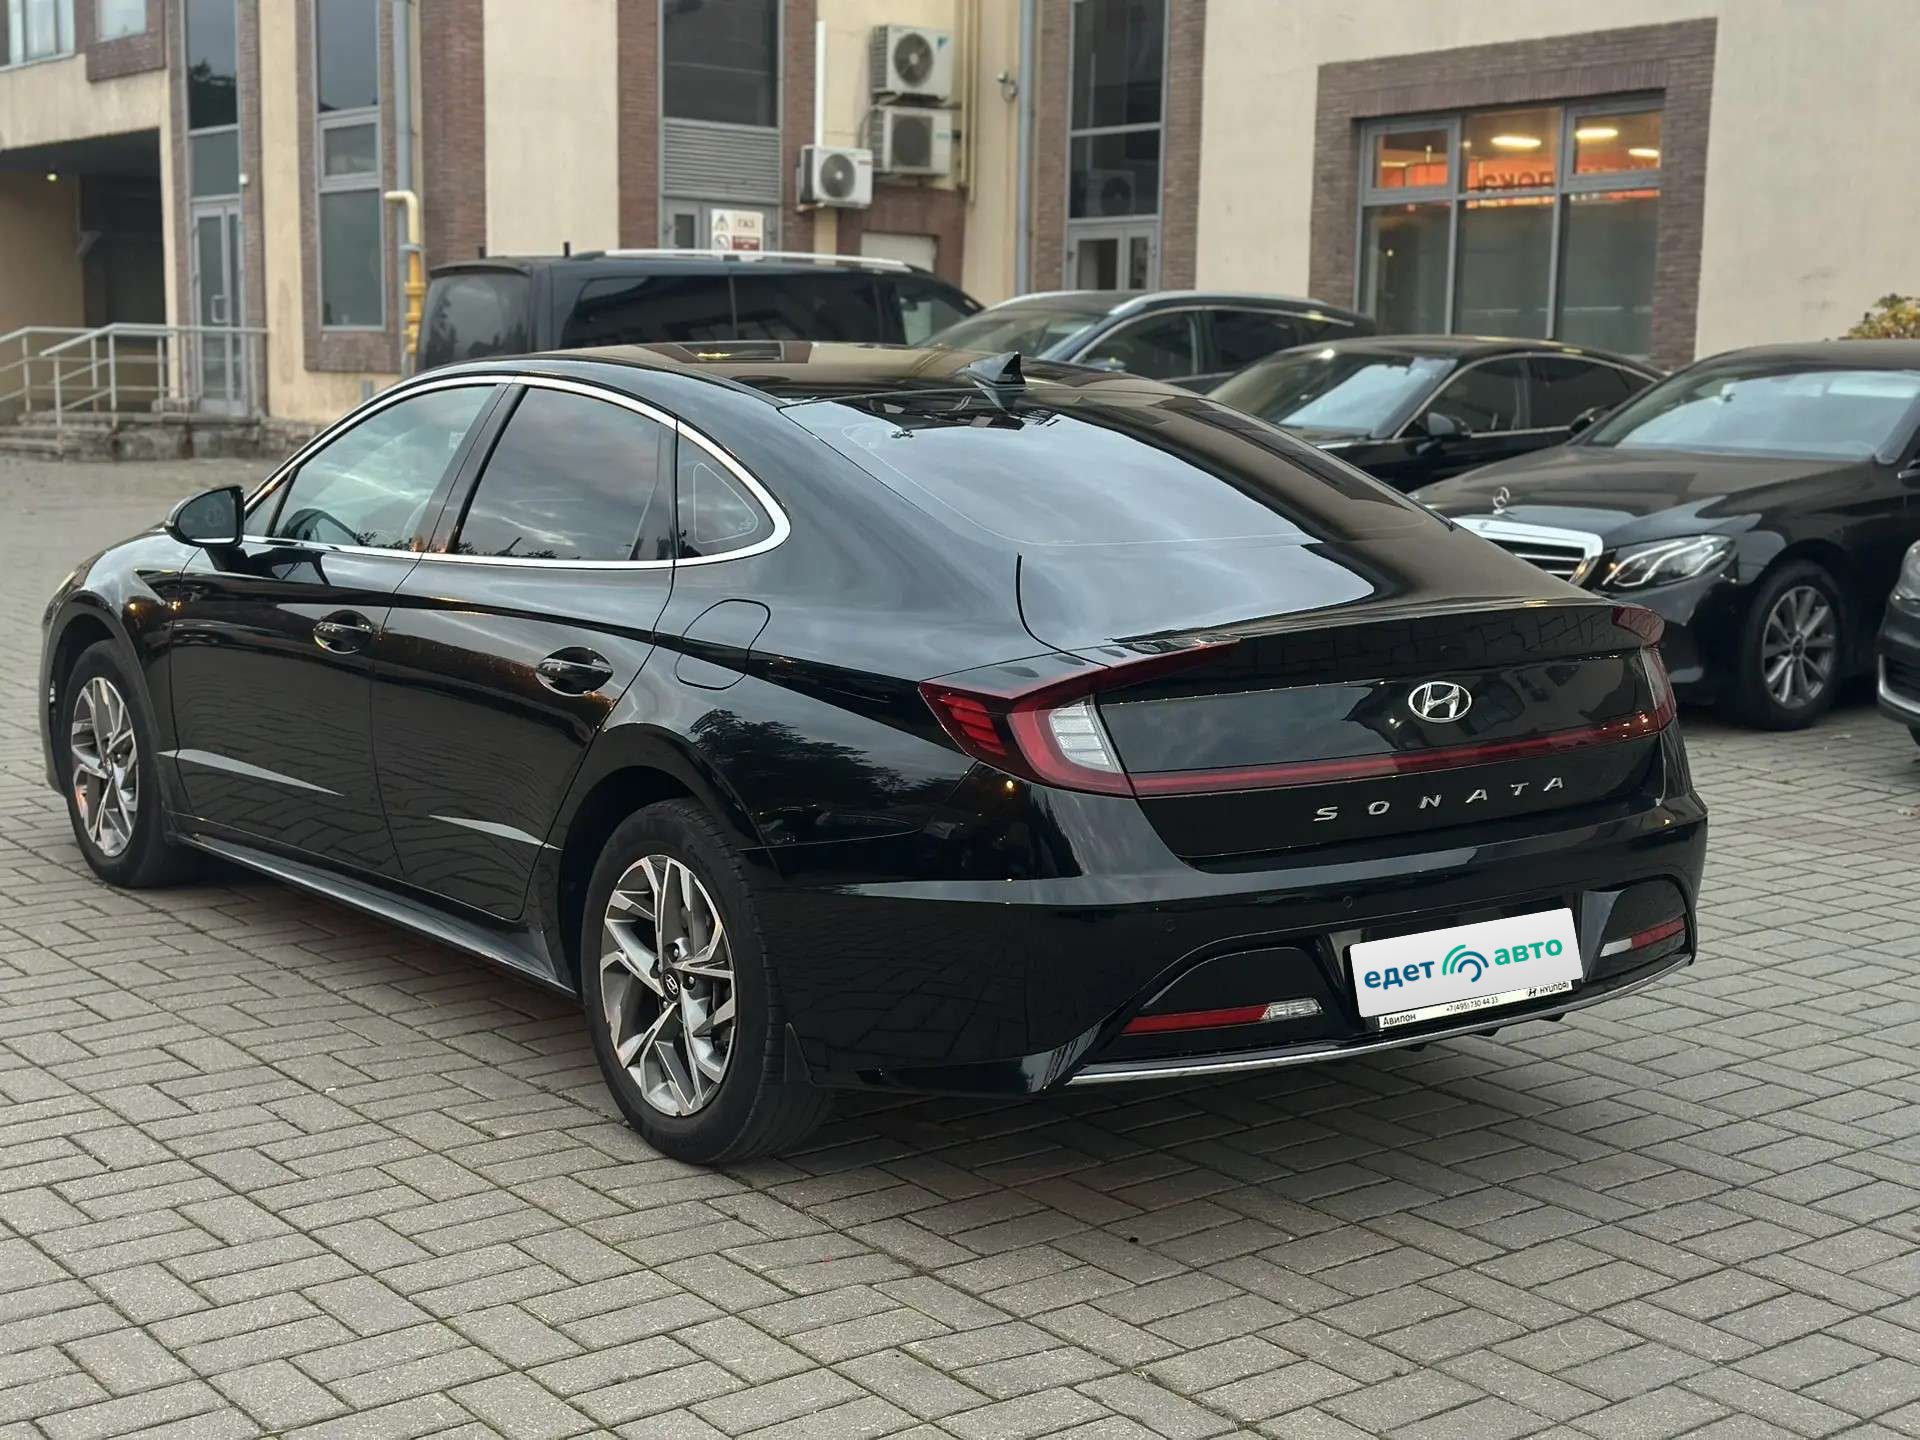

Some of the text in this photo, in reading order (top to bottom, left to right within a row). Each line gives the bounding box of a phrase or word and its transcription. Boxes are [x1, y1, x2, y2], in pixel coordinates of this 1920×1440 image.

[1313, 776, 1564, 822] SONATA
[1539, 982, 1570, 994] HYUNDAI
[1454, 1002, 1470, 1012] (495)
[1471, 999, 1482, 1008] 730
[1482, 996, 1491, 1006] 44
[1382, 1013, 1417, 1026] Авилон
